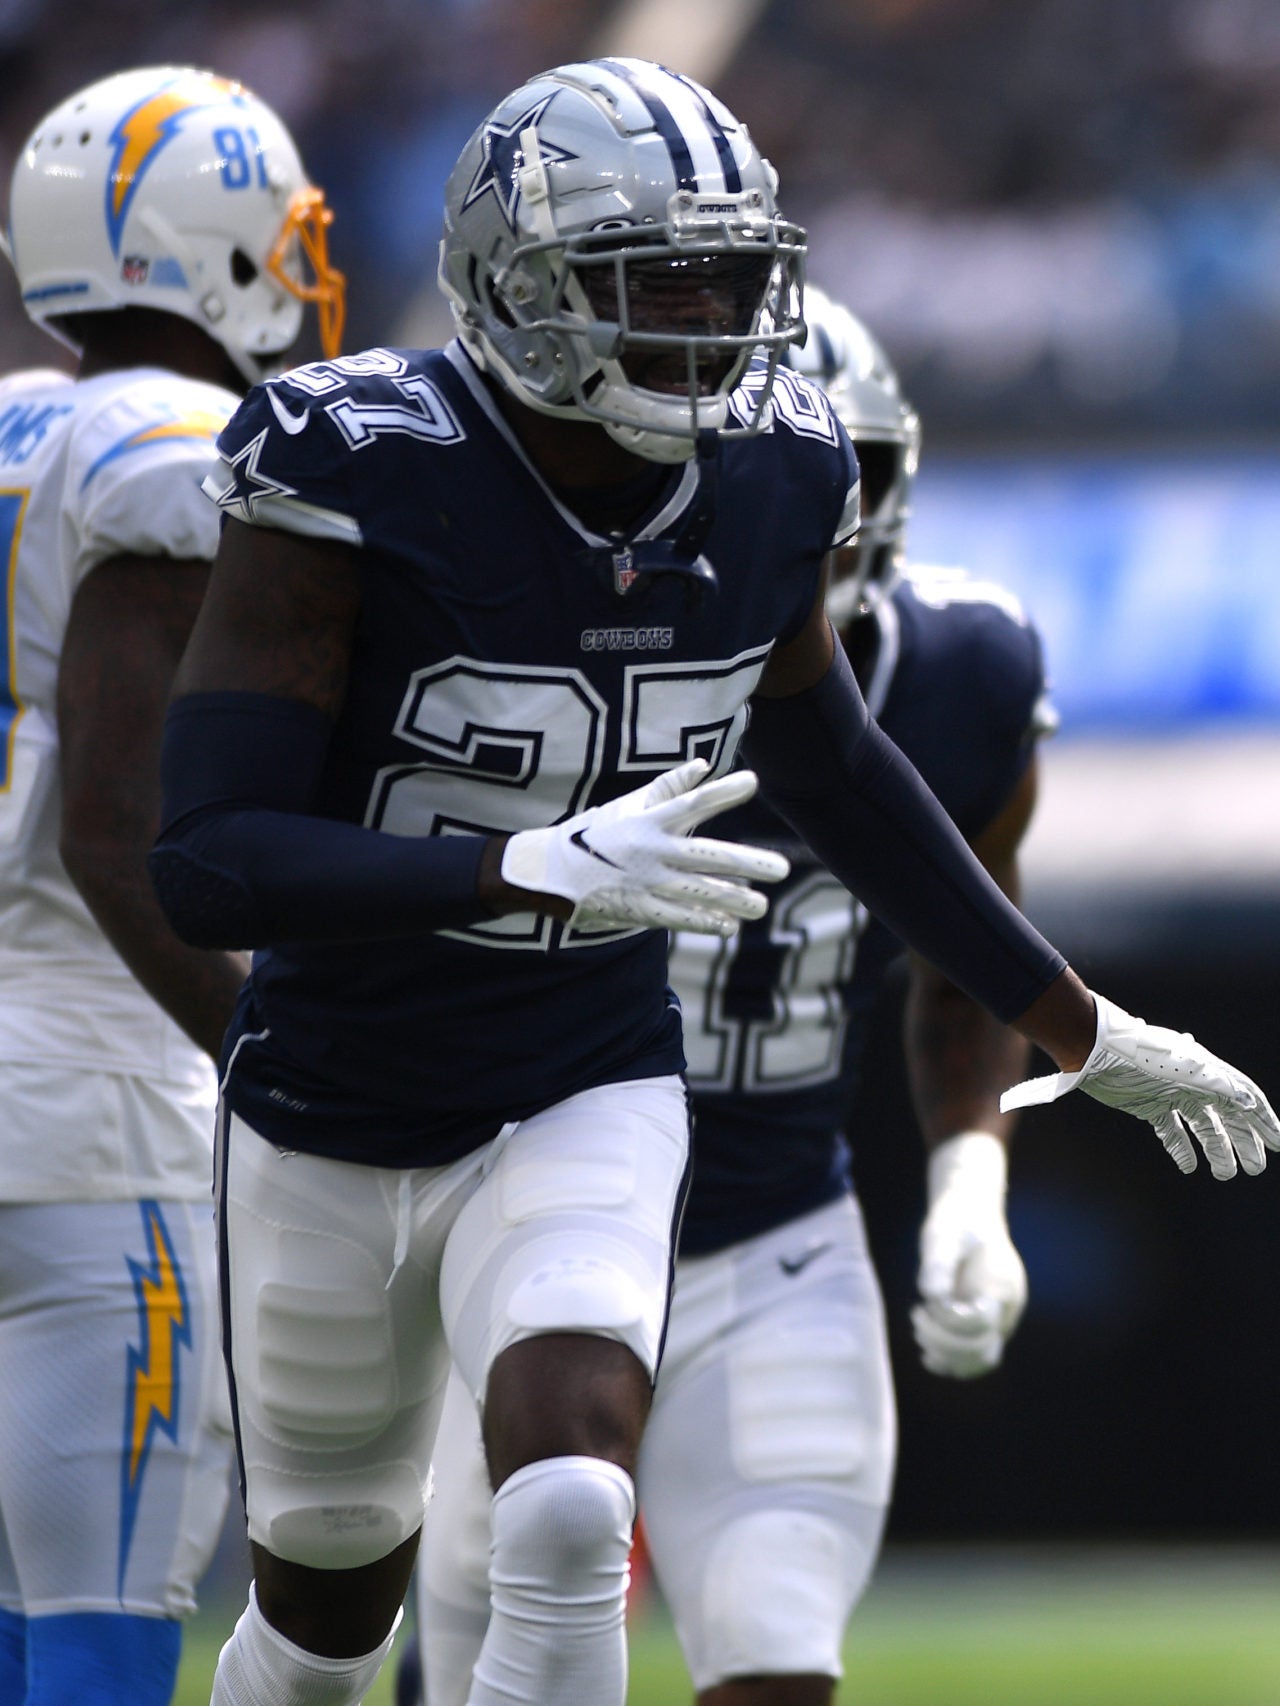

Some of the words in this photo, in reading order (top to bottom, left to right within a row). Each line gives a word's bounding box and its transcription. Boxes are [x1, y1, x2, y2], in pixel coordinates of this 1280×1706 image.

[696, 204, 738, 214] OWBOYS
[581, 627, 674, 650] COWBOYS
[364, 638, 776, 952] 27
